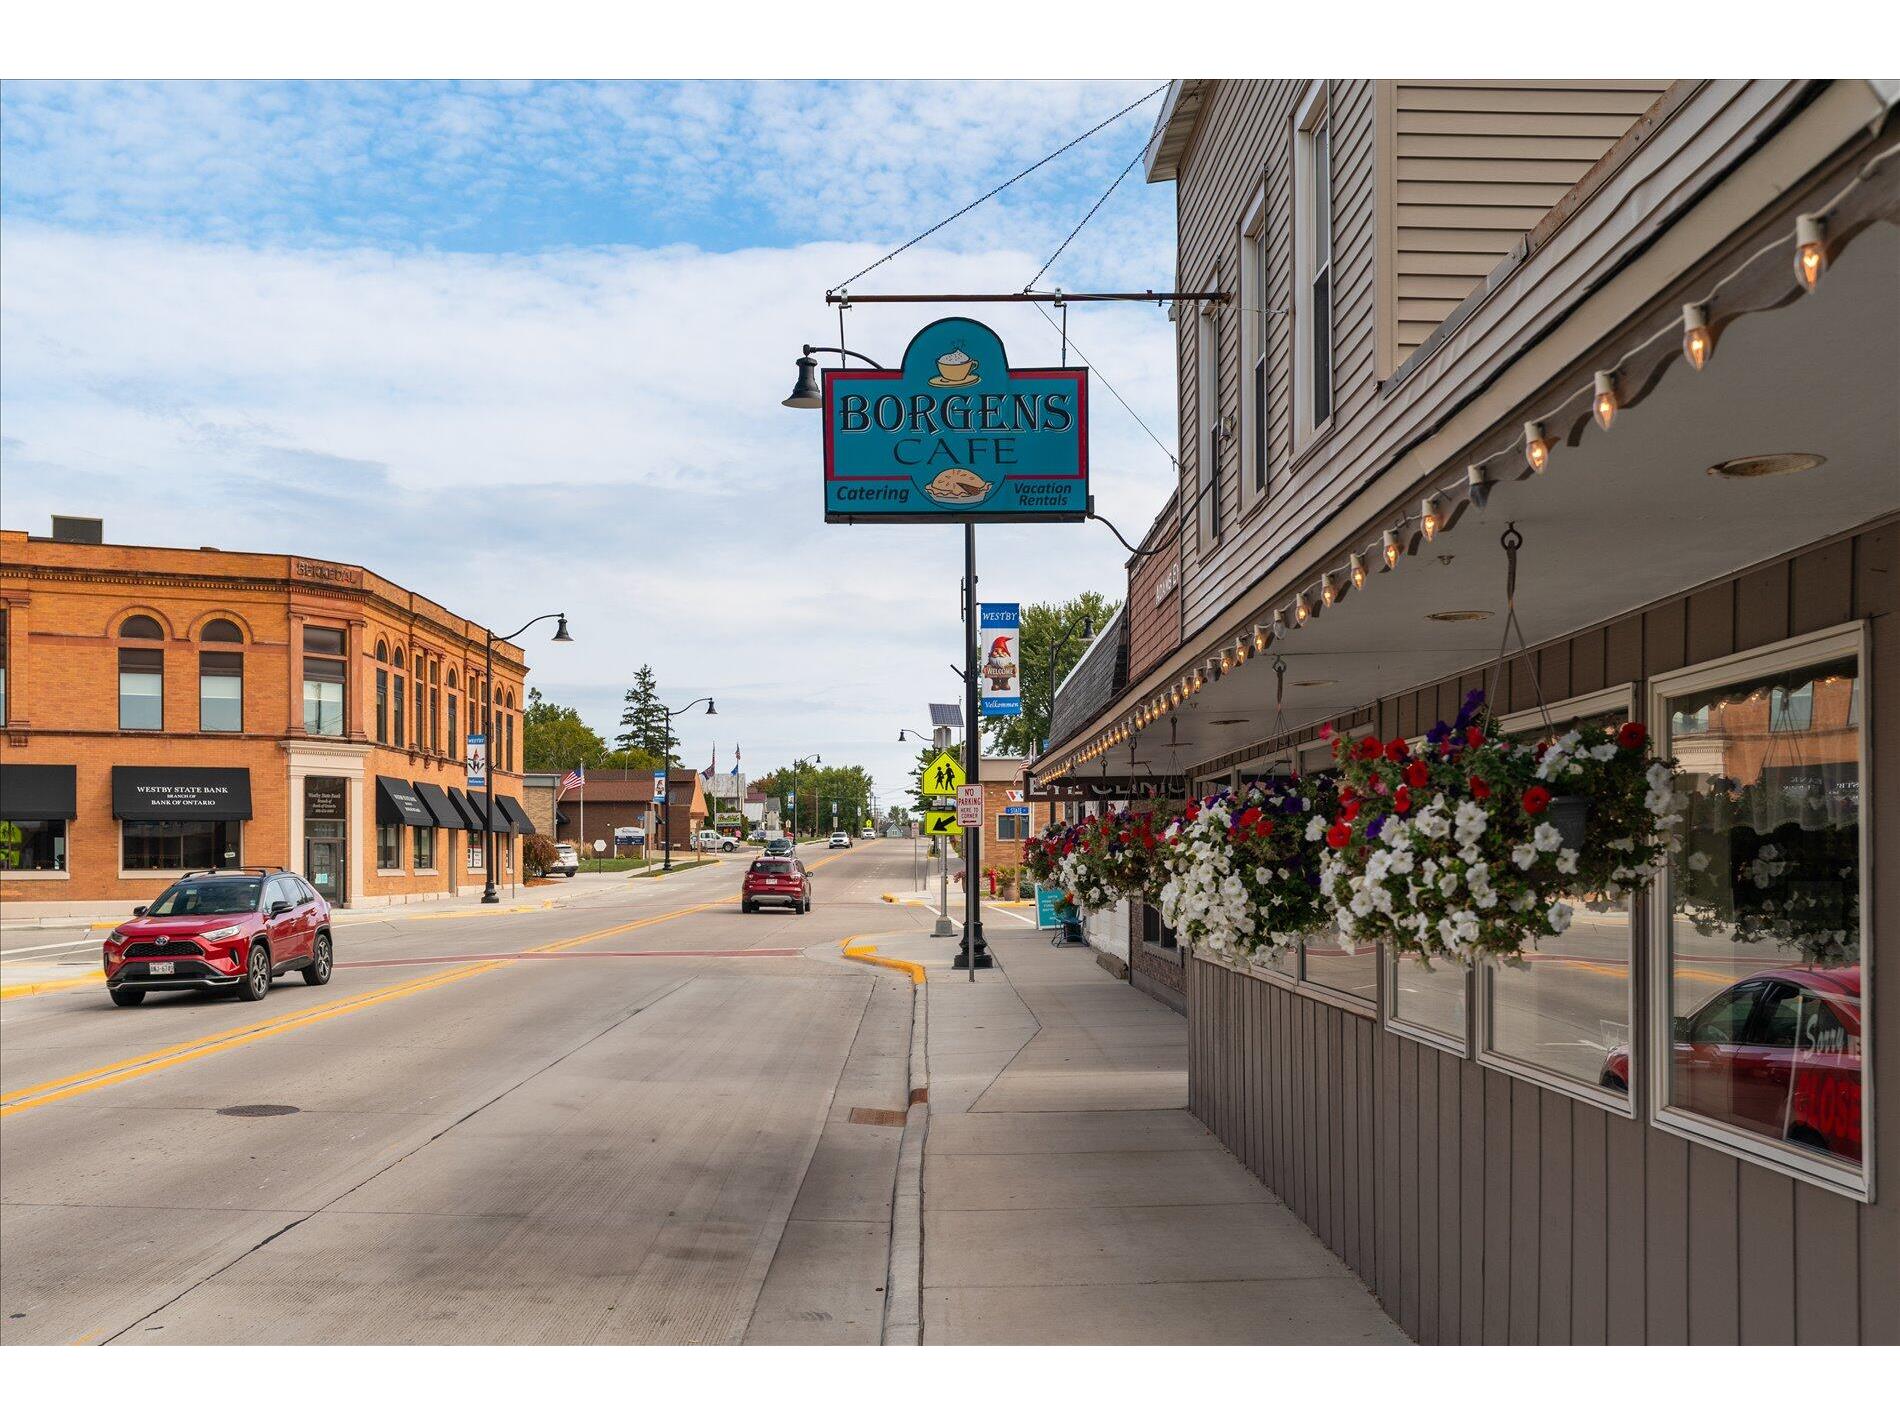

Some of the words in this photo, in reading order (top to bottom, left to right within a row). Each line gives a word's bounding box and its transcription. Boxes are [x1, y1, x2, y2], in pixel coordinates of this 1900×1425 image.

[840, 393, 1074, 436] BORGENS
[893, 437, 1019, 465] CAFE
[1014, 481, 1072, 495] Vacation
[836, 485, 910, 504] Catering
[1019, 494, 1068, 507] Rentals
[982, 611, 1018, 621] WESTBY
[986, 667, 1014, 676] WELCOME
[984, 700, 1019, 708] Velkommen
[965, 788, 975, 796] NO
[959, 798, 981, 806] PARKING
